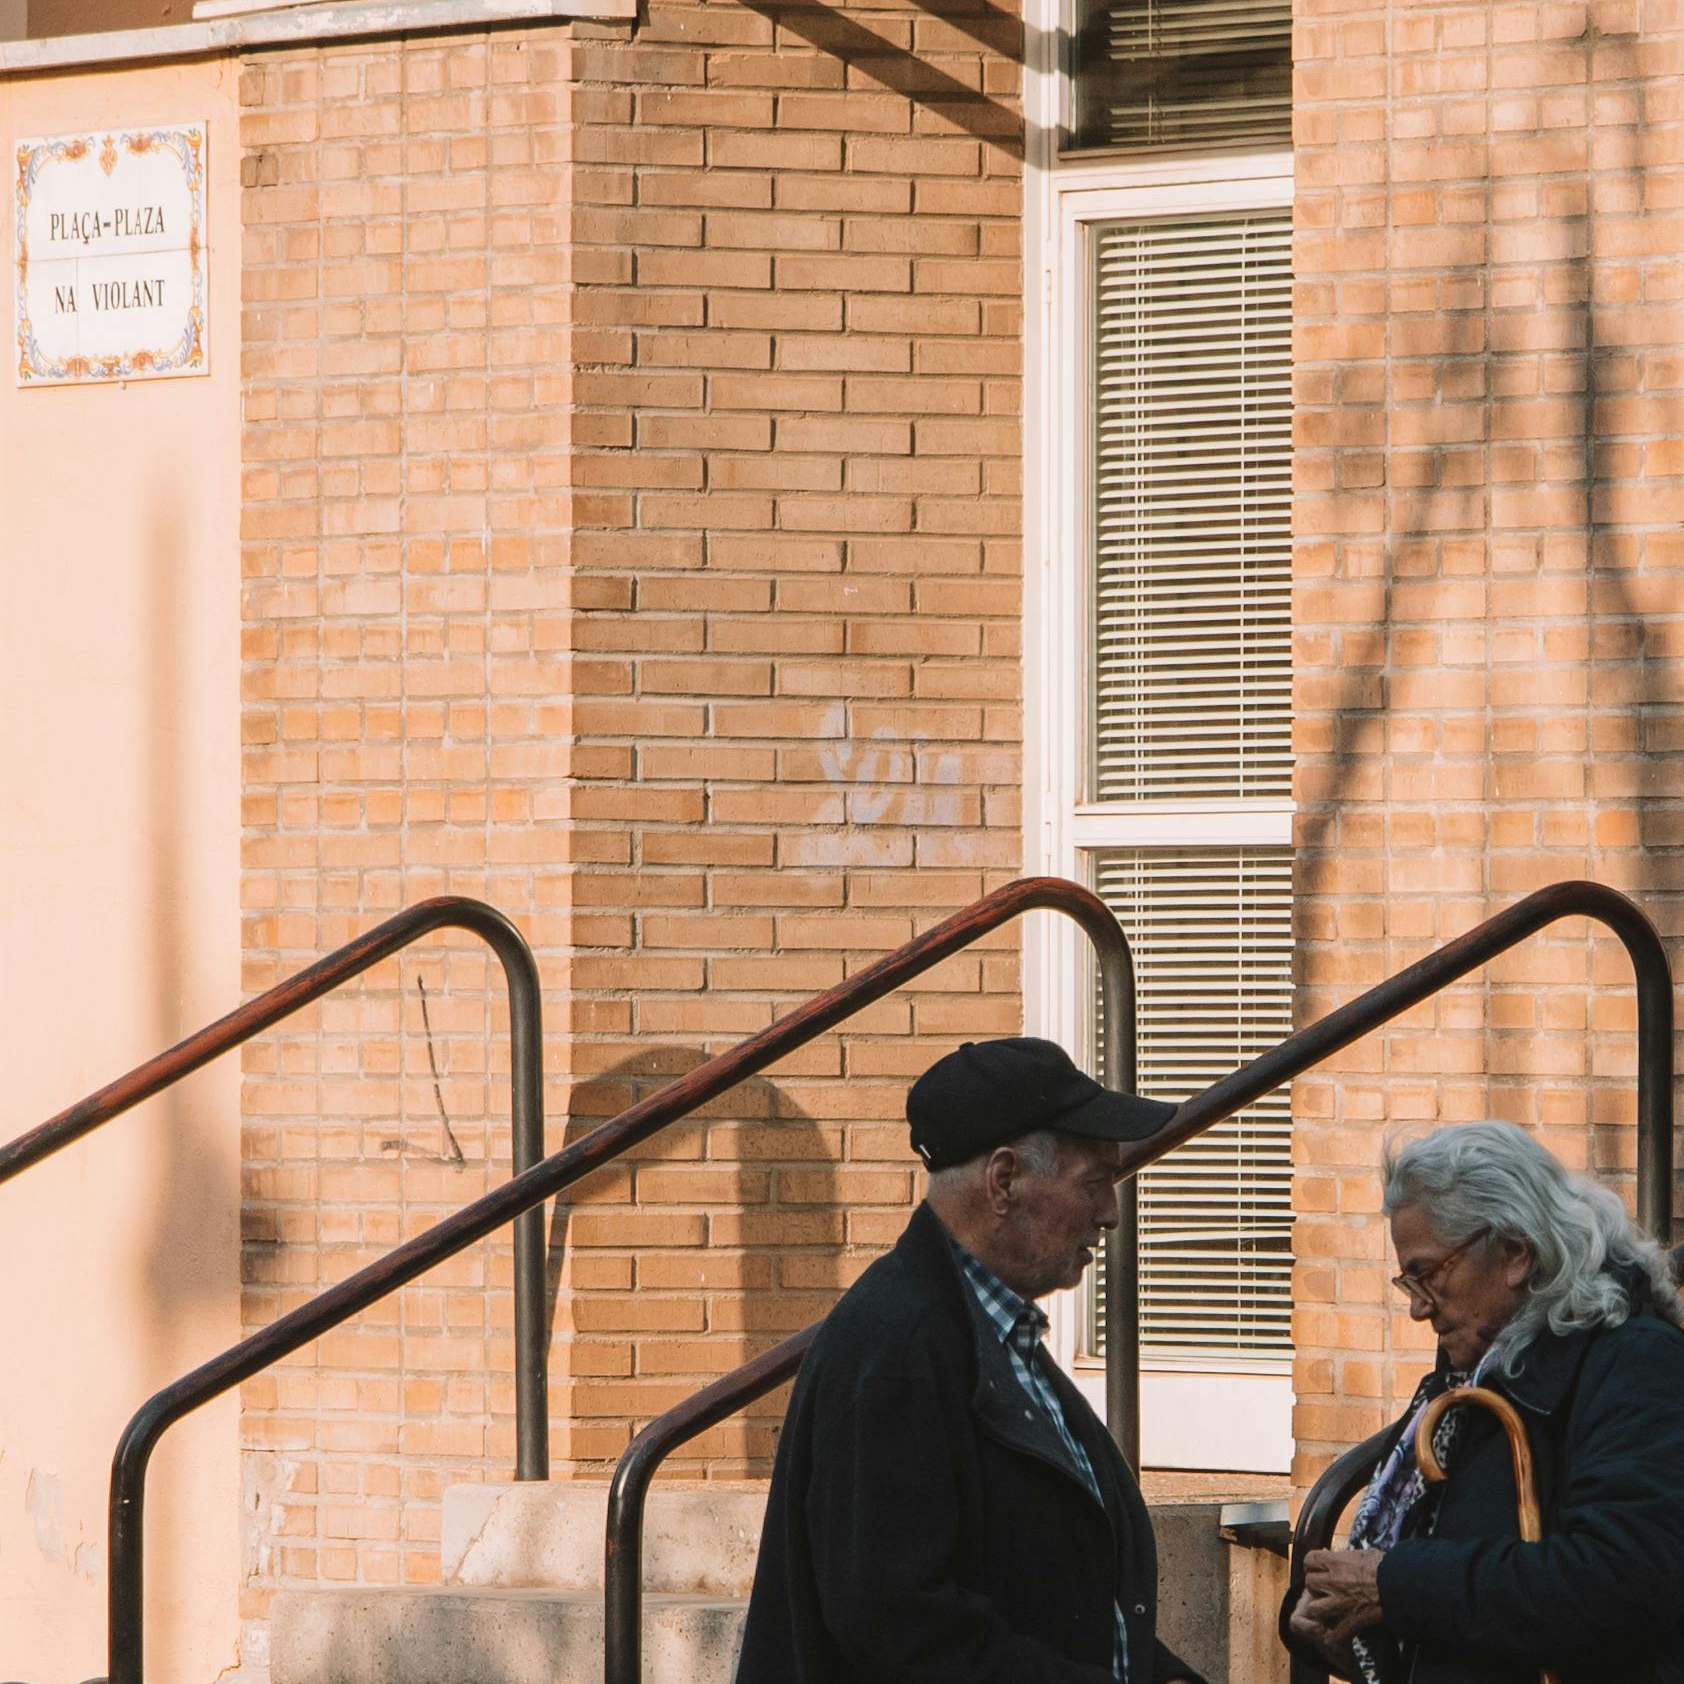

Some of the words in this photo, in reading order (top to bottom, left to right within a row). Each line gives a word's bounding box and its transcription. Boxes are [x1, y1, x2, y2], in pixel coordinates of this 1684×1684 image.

[50, 206, 166, 245] PLAÇA-PLAZA
[54, 285, 77, 314] NA
[92, 279, 166, 311] VIOLANT
